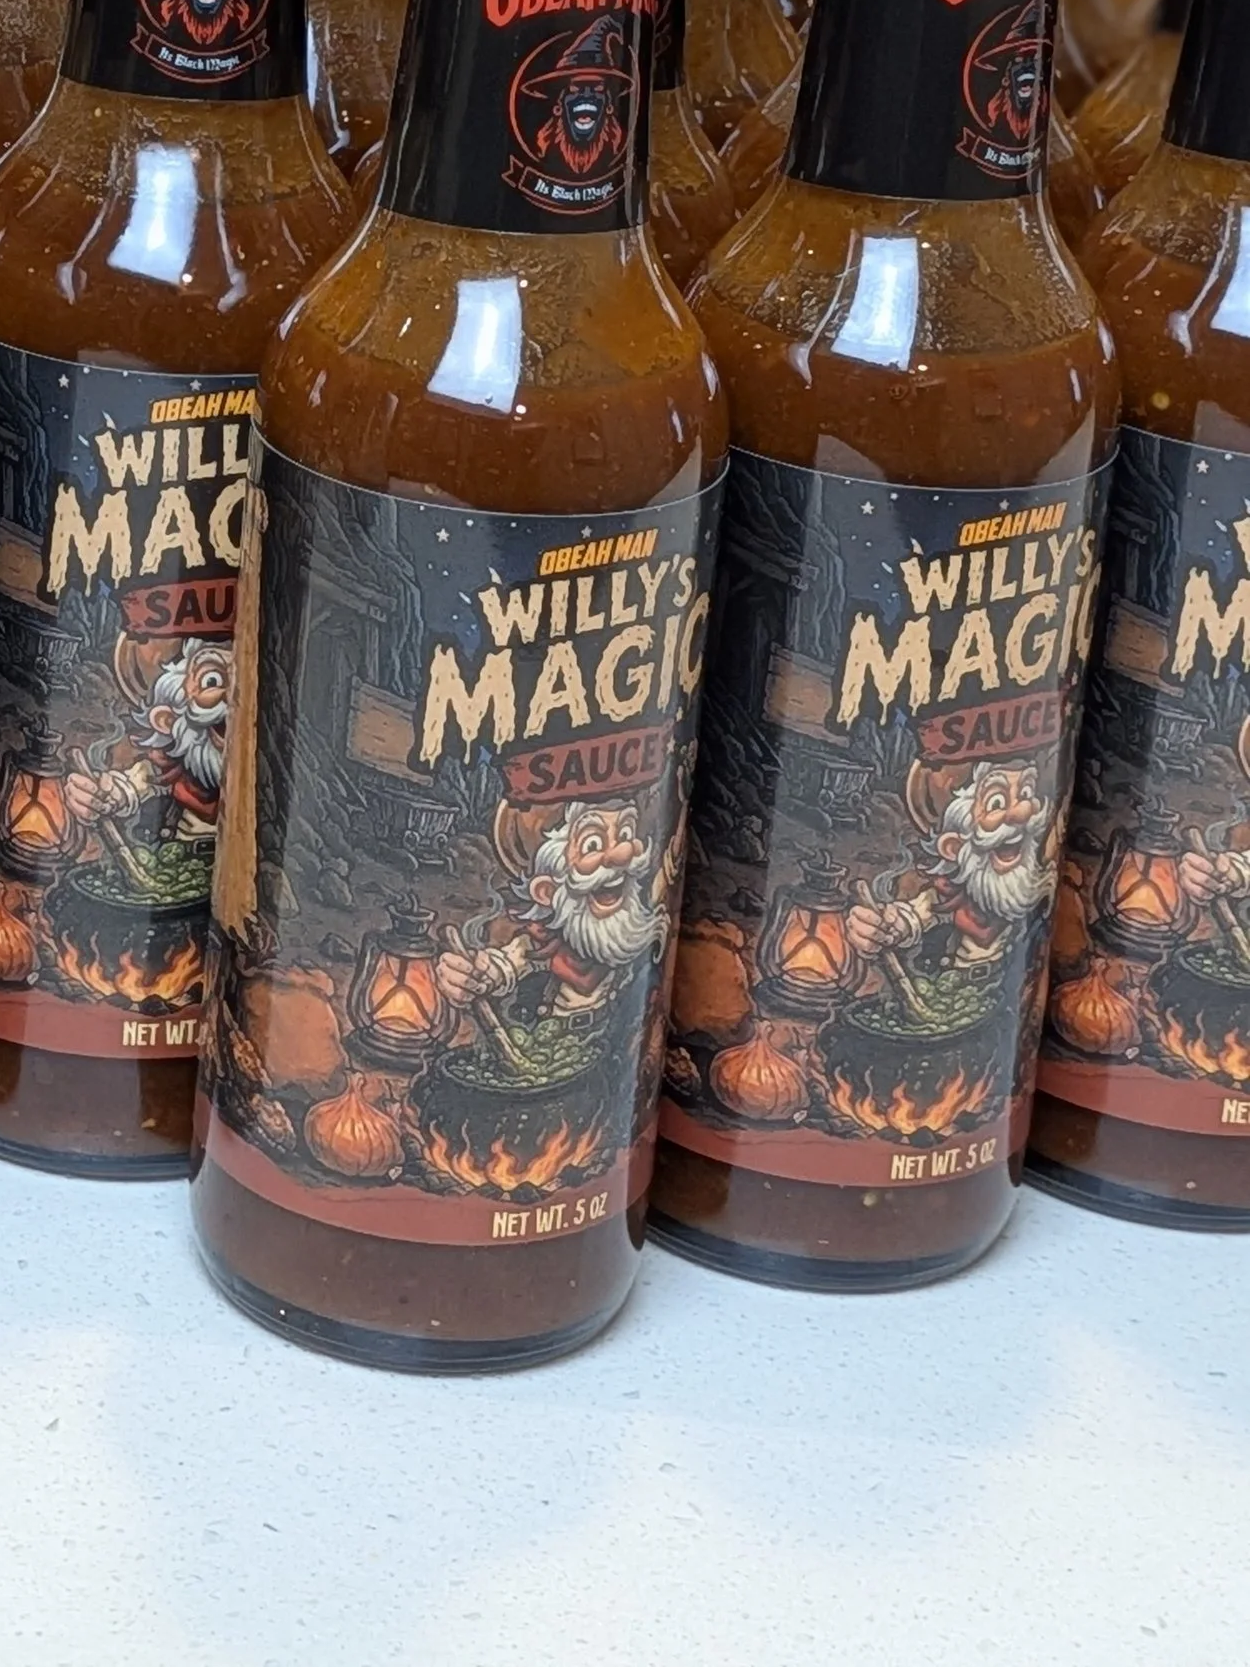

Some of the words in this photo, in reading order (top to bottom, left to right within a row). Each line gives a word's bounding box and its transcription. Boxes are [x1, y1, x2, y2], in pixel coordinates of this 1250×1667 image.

[151, 392, 225, 424] OBEAH
[223, 389, 257, 416] MA
[94, 422, 250, 488] WILL
[958, 509, 1029, 547] OBEAH
[1026, 501, 1068, 534] MAN
[539, 537, 614, 576] OBEAH
[612, 528, 659, 563] MAN
[899, 525, 1097, 615] WILLY'S
[144, 588, 236, 627] SAU
[478, 553, 698, 646] WILLY'S
[836, 561, 1103, 732] MAGIC
[420, 591, 710, 770] MAGIC
[940, 699, 1061, 755] SAUCE
[526, 732, 657, 794] SAUCE
[122, 1020, 160, 1047] NET
[1220, 1097, 1250, 1125] NE
[890, 1154, 928, 1181] NET
[931, 1147, 963, 1177] WT.
[965, 1142, 979, 1170] 5
[979, 1137, 998, 1165] OZ
[492, 1211, 531, 1239] NET
[535, 1203, 569, 1234] WT.
[573, 1197, 587, 1225] 5
[589, 1191, 609, 1220] OZ
